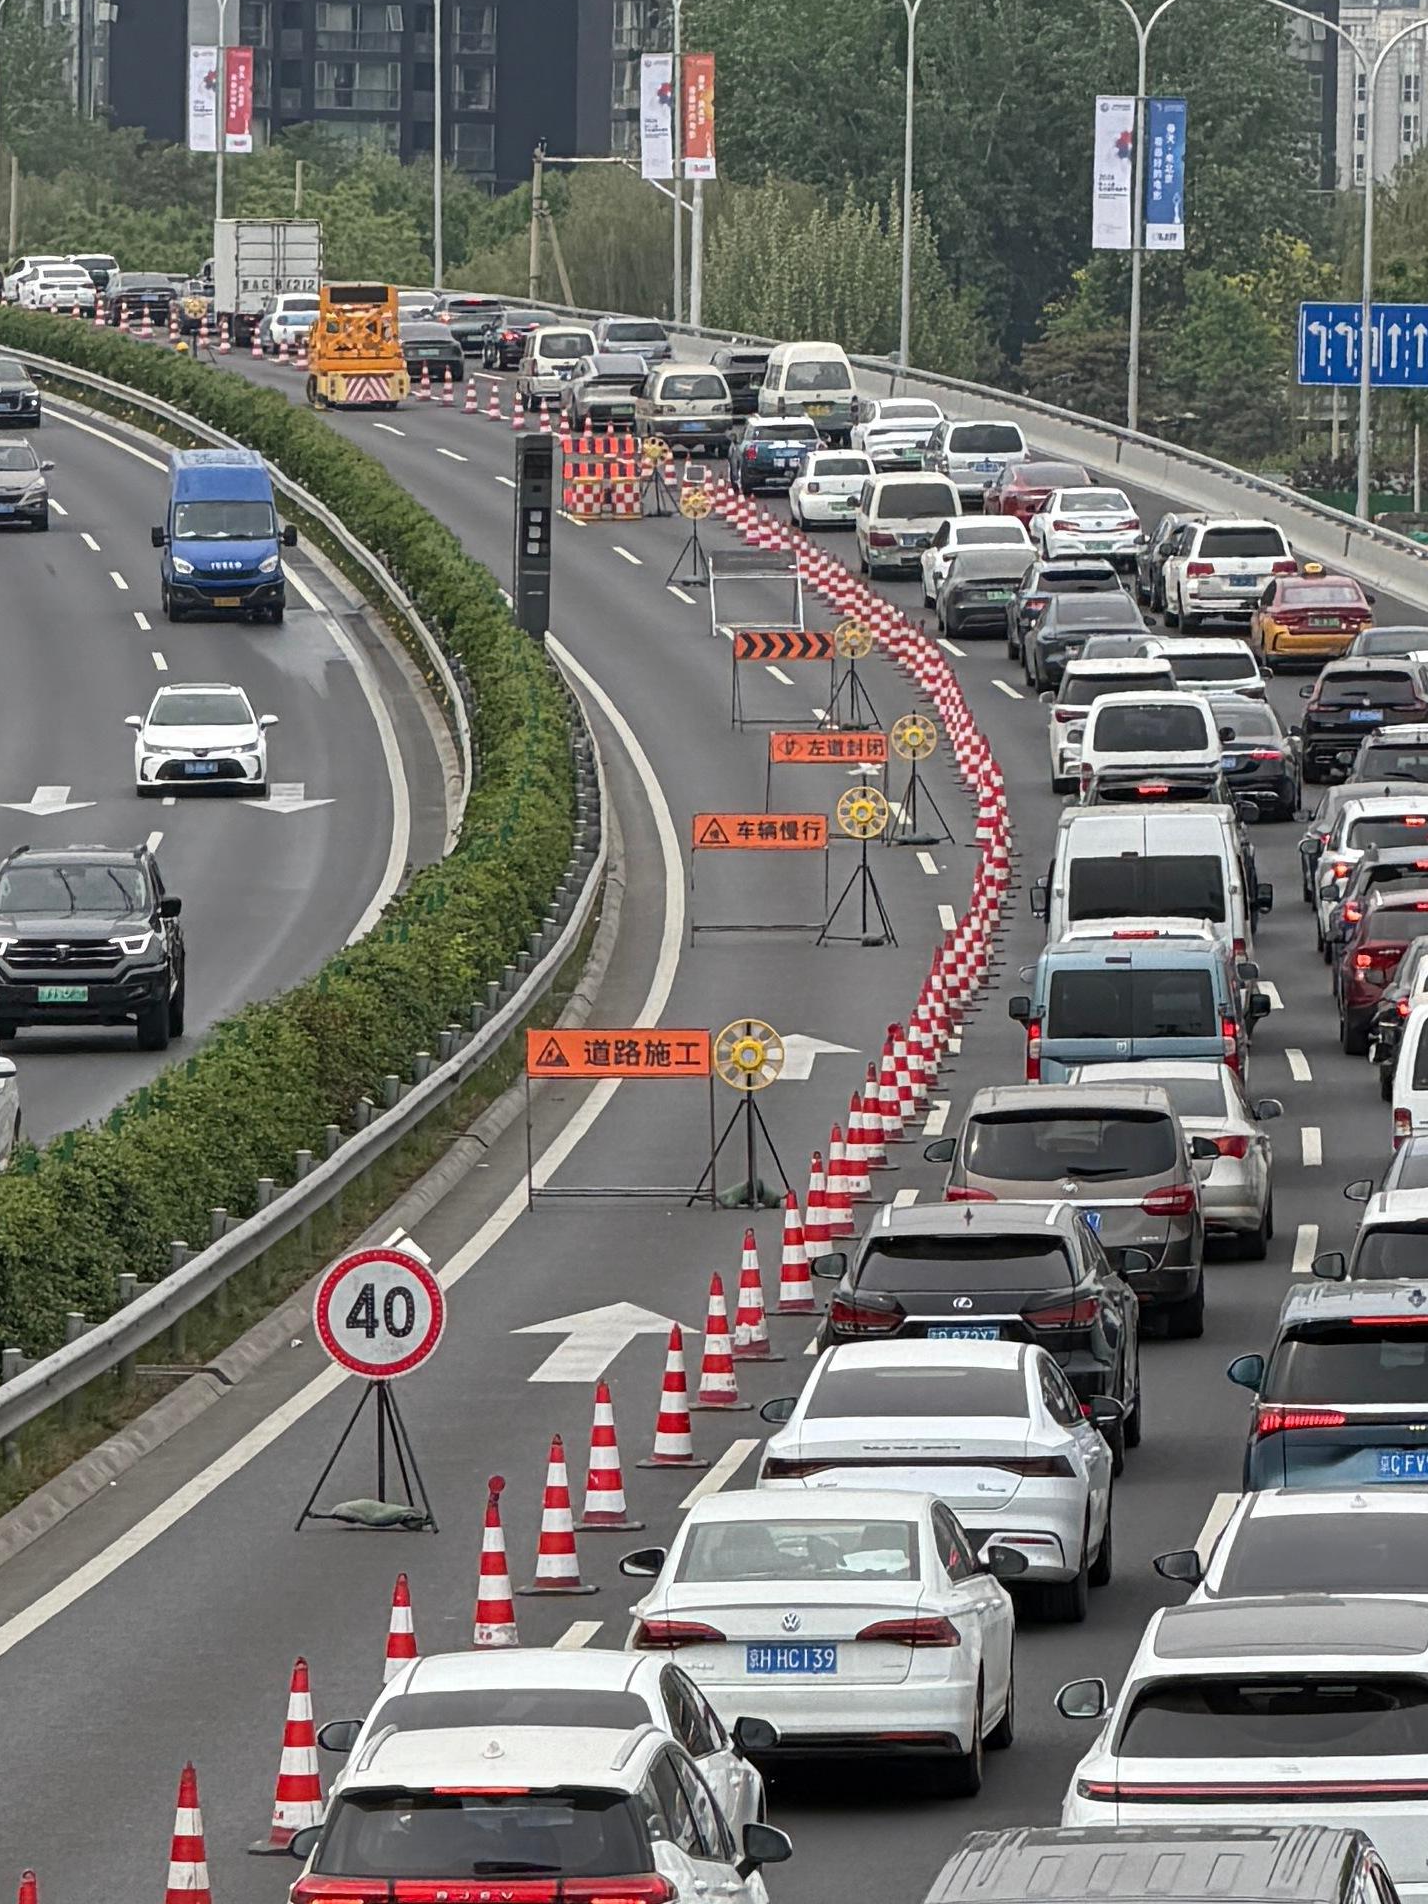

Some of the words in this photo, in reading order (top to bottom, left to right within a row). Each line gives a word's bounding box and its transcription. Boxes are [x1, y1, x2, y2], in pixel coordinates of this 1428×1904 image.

[807, 738, 885, 757] 左道封闭
[737, 820, 821, 841] 车辆慢行
[584, 1039, 701, 1067] 道路施工
[346, 1283, 415, 1338] 40
